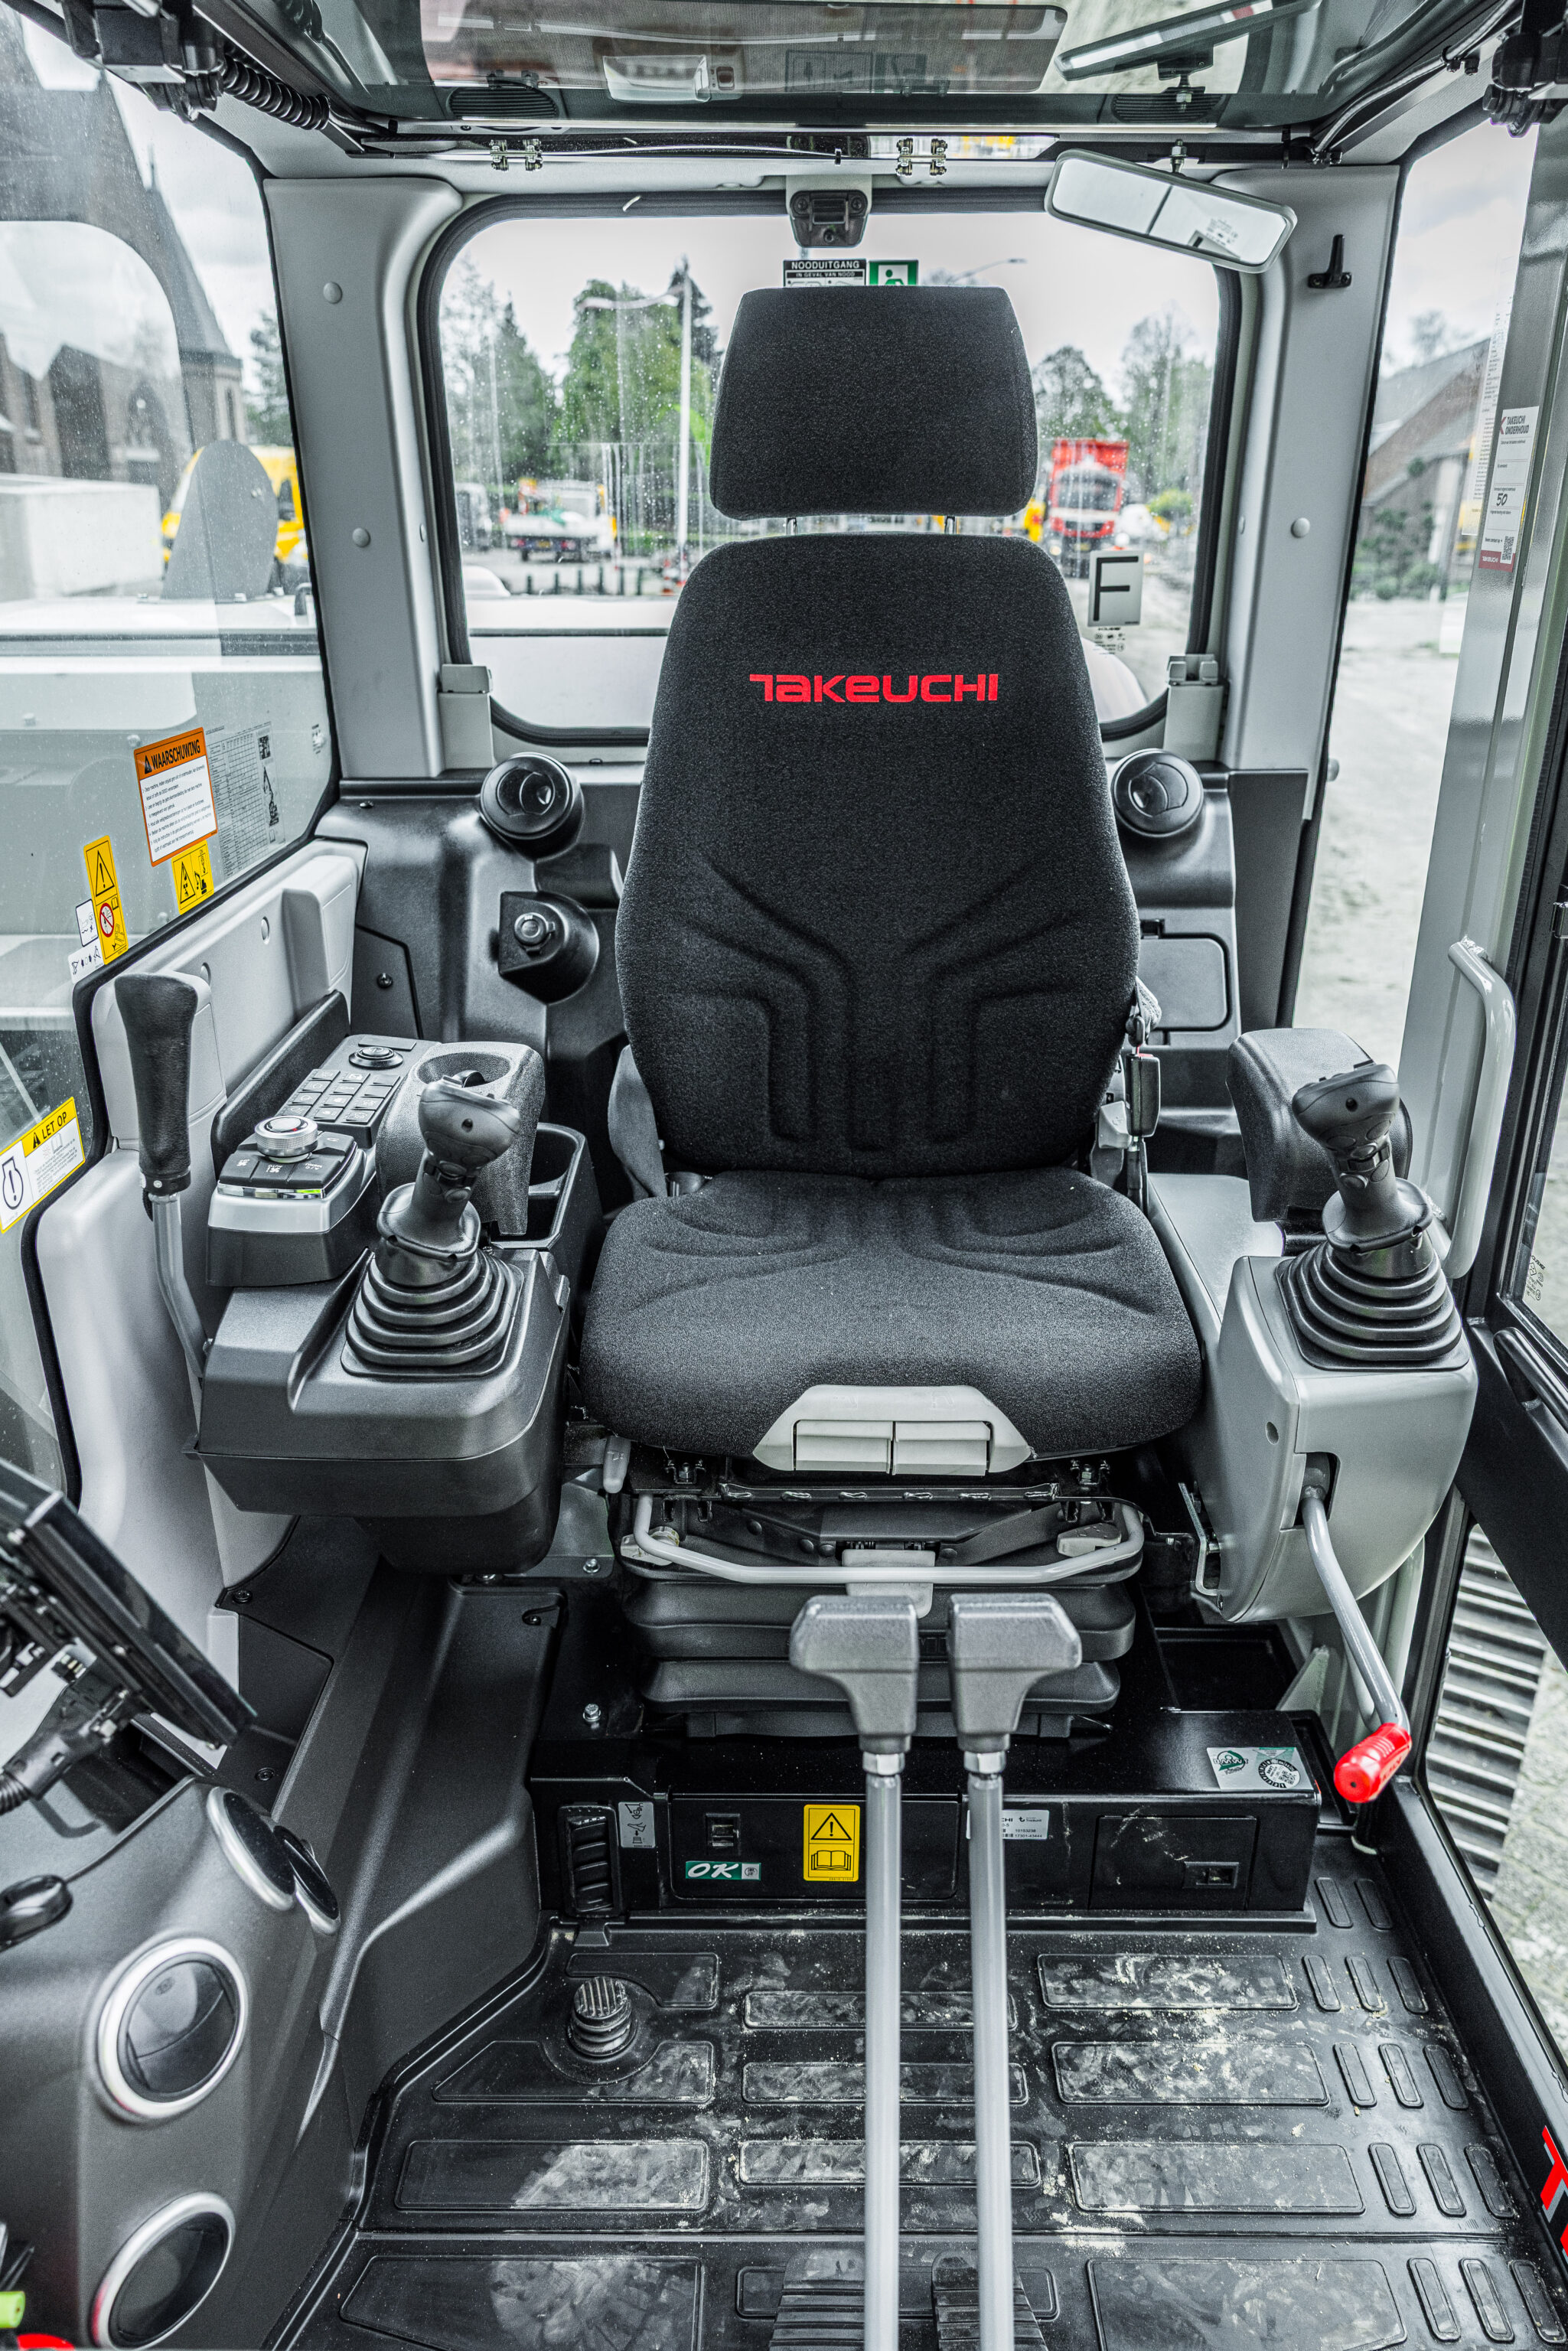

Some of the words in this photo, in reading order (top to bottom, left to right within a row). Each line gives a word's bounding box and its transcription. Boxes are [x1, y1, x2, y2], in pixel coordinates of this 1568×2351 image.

[791, 261, 860, 270] NOODUITGANG
[1507, 416, 1526, 426] TAKEUCHI
[1505, 425, 1530, 435] ONDERHOUD
[1496, 493, 1508, 506] 50
[1093, 556, 1139, 621] F
[749, 673, 999, 703] TAKEUCHI
[151, 739, 200, 770] WAARSCHUWING
[42, 1120, 54, 1140] LET
[57, 1111, 67, 1127] OP
[687, 1863, 739, 1879] OK
